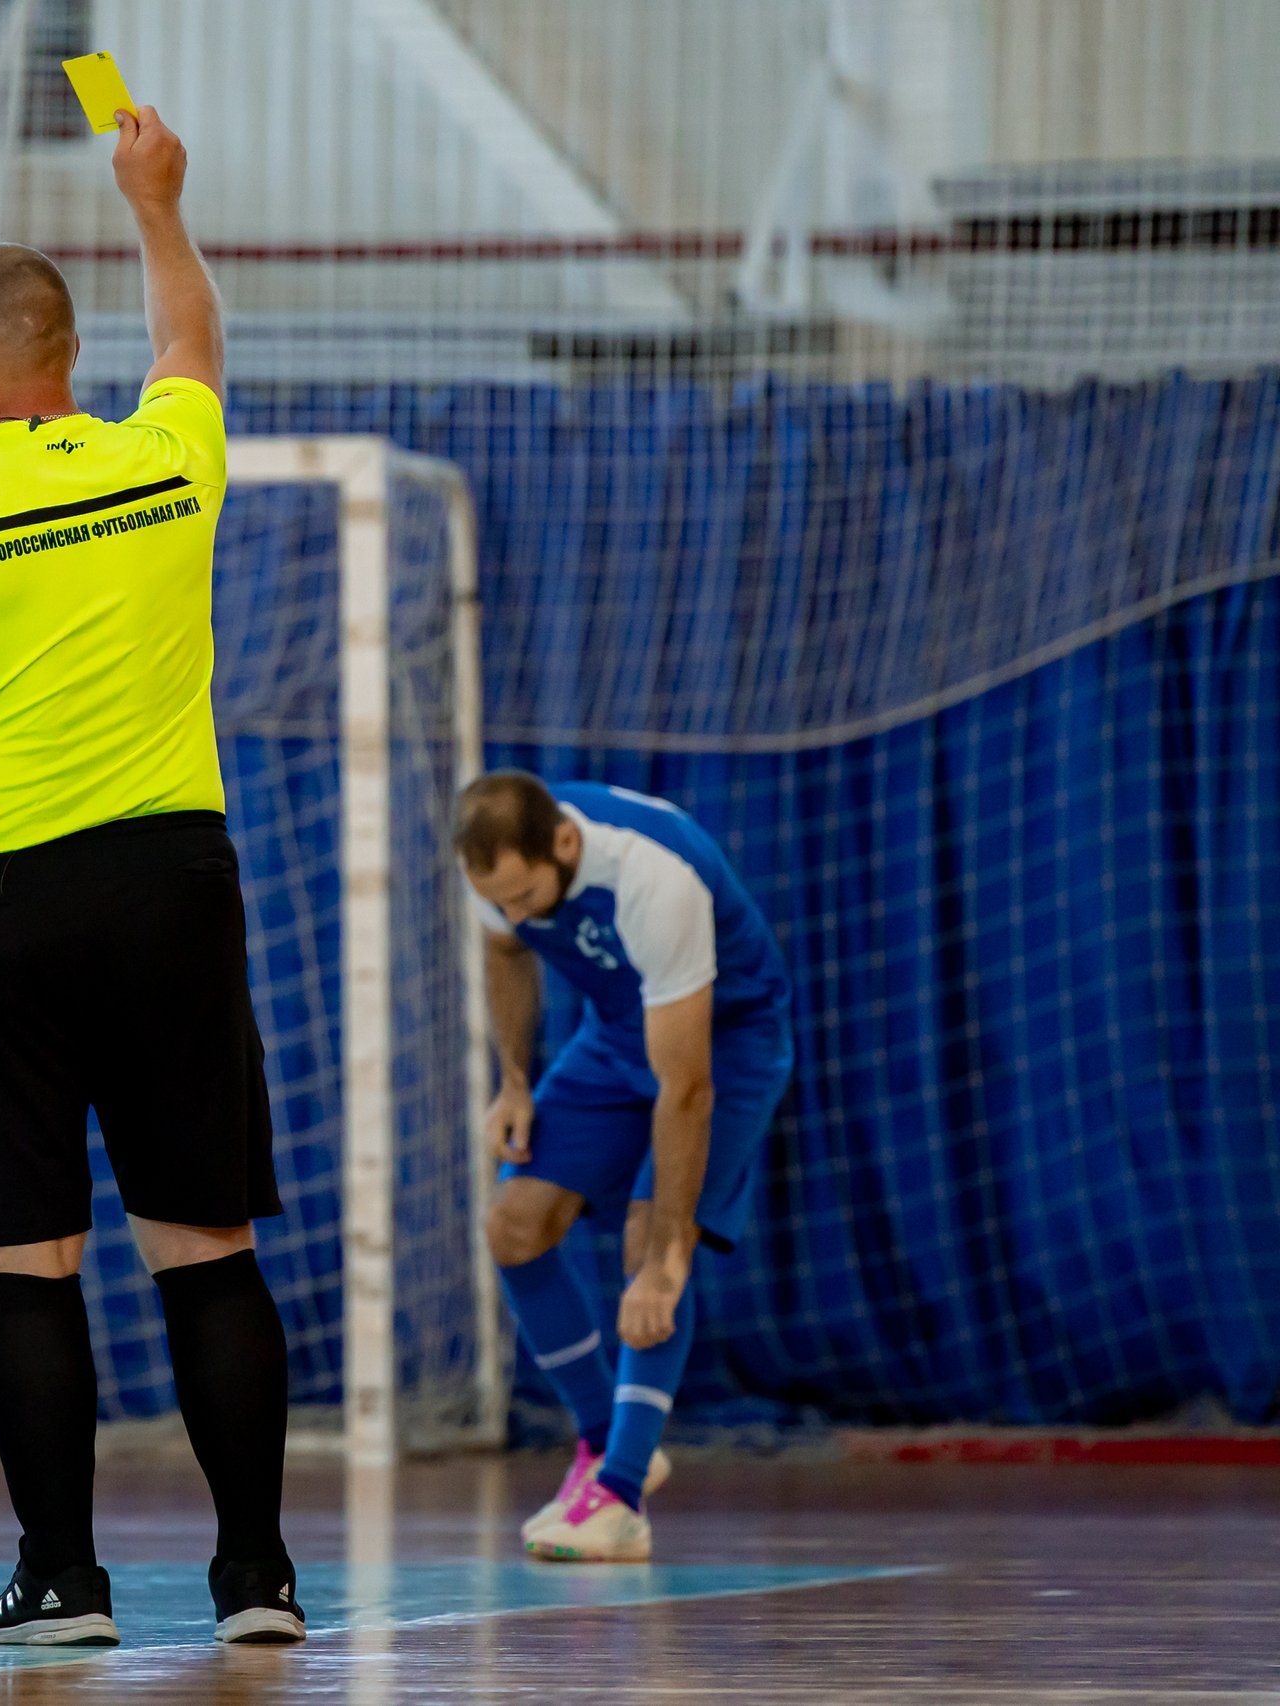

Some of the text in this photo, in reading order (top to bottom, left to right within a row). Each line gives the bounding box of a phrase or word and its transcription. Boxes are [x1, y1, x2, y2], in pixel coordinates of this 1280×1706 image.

[92, 507, 176, 539] ФУТБОЛЬНАЯ
[174, 496, 201, 519] ЛИГА
[41, 1601, 61, 1610] adidas
